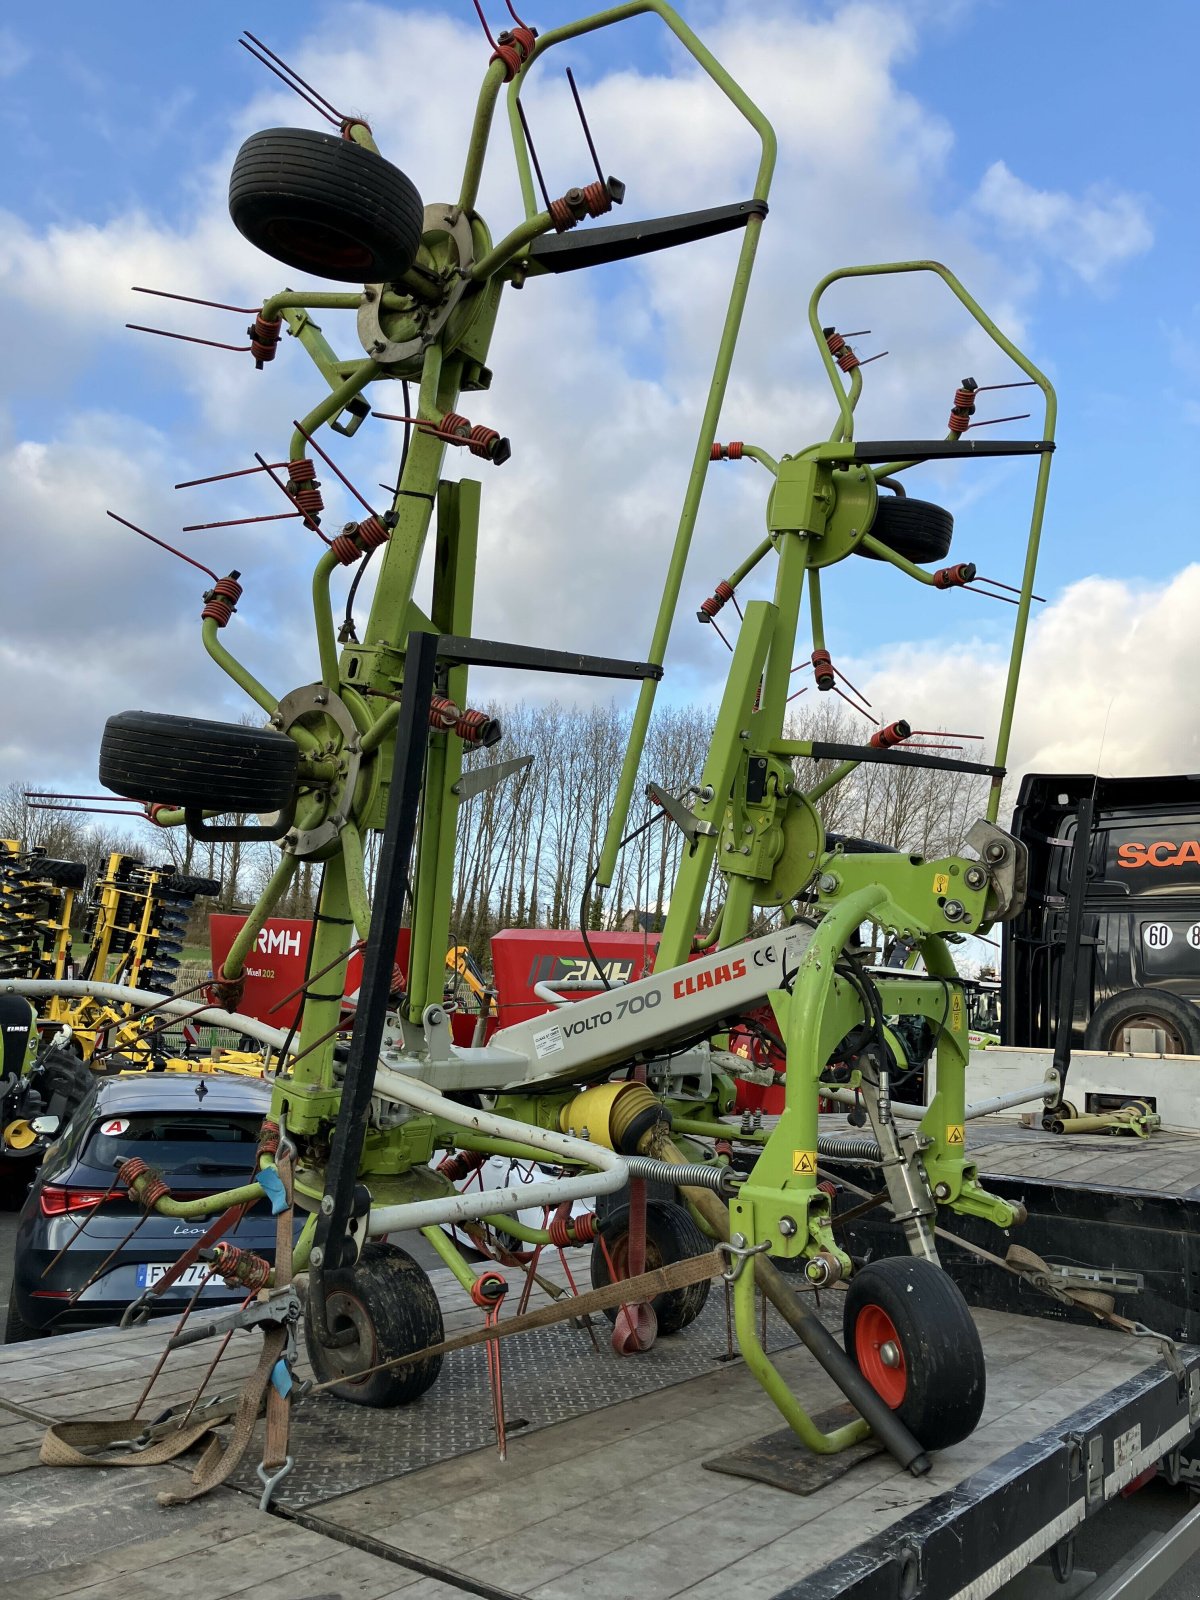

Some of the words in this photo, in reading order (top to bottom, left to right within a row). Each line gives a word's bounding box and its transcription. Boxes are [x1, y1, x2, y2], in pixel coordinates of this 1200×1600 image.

[252, 928, 300, 957] RMH
[1149, 925, 1168, 946] 60
[753, 946, 775, 966] CE
[262, 969, 275, 978] 202
[560, 959, 633, 982] RMH
[673, 958, 746, 999] CLAAS
[563, 1011, 613, 1038] VOLTO
[616, 990, 662, 1020] 700
[105, 1120, 122, 1133] A
